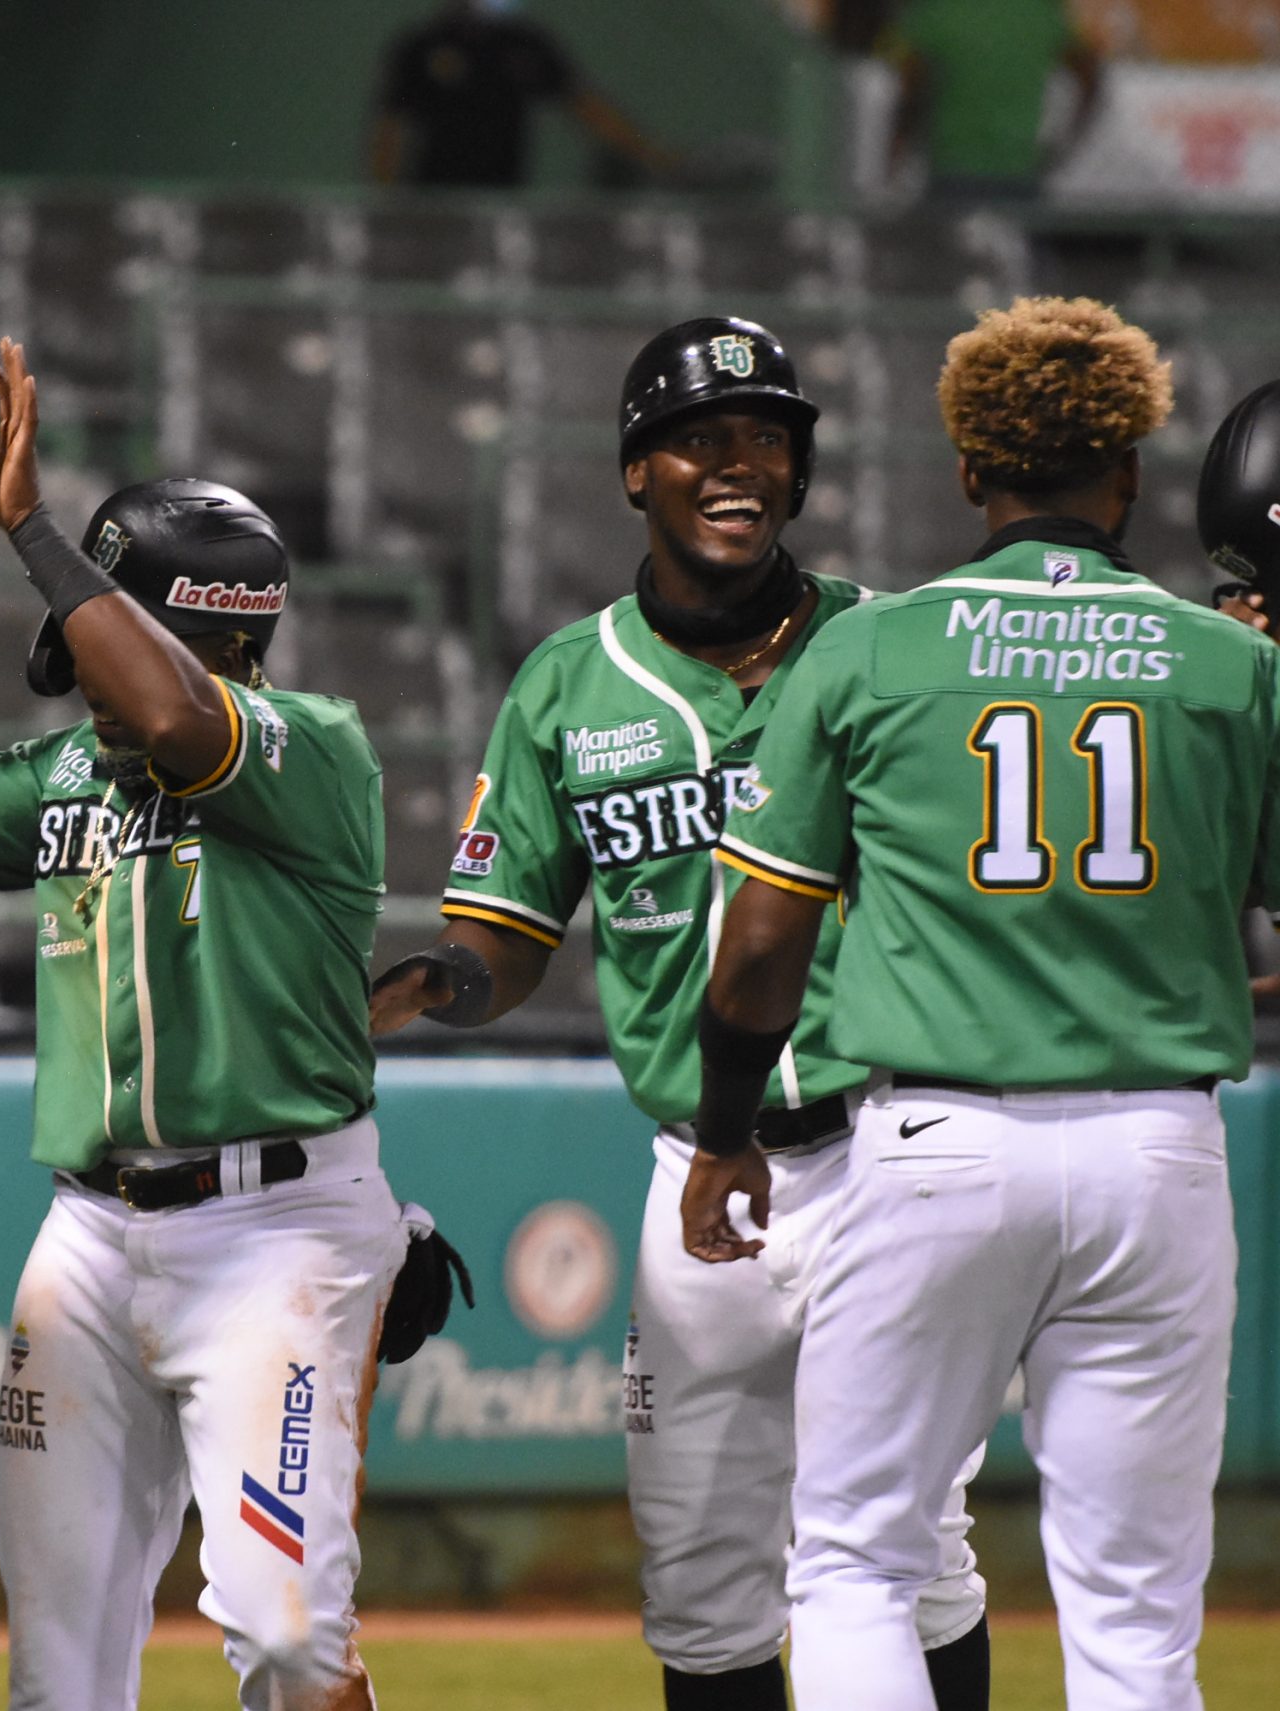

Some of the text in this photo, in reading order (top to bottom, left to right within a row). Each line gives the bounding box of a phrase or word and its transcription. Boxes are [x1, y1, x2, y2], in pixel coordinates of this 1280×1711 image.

[174, 580, 286, 611] La Colonial
[945, 598, 1169, 643] Manitas
[969, 634, 1174, 693] limpias
[566, 718, 659, 755] Manitas
[577, 740, 663, 776] limpias
[966, 701, 1159, 894] 11
[277, 1361, 317, 1496] CEMEX
